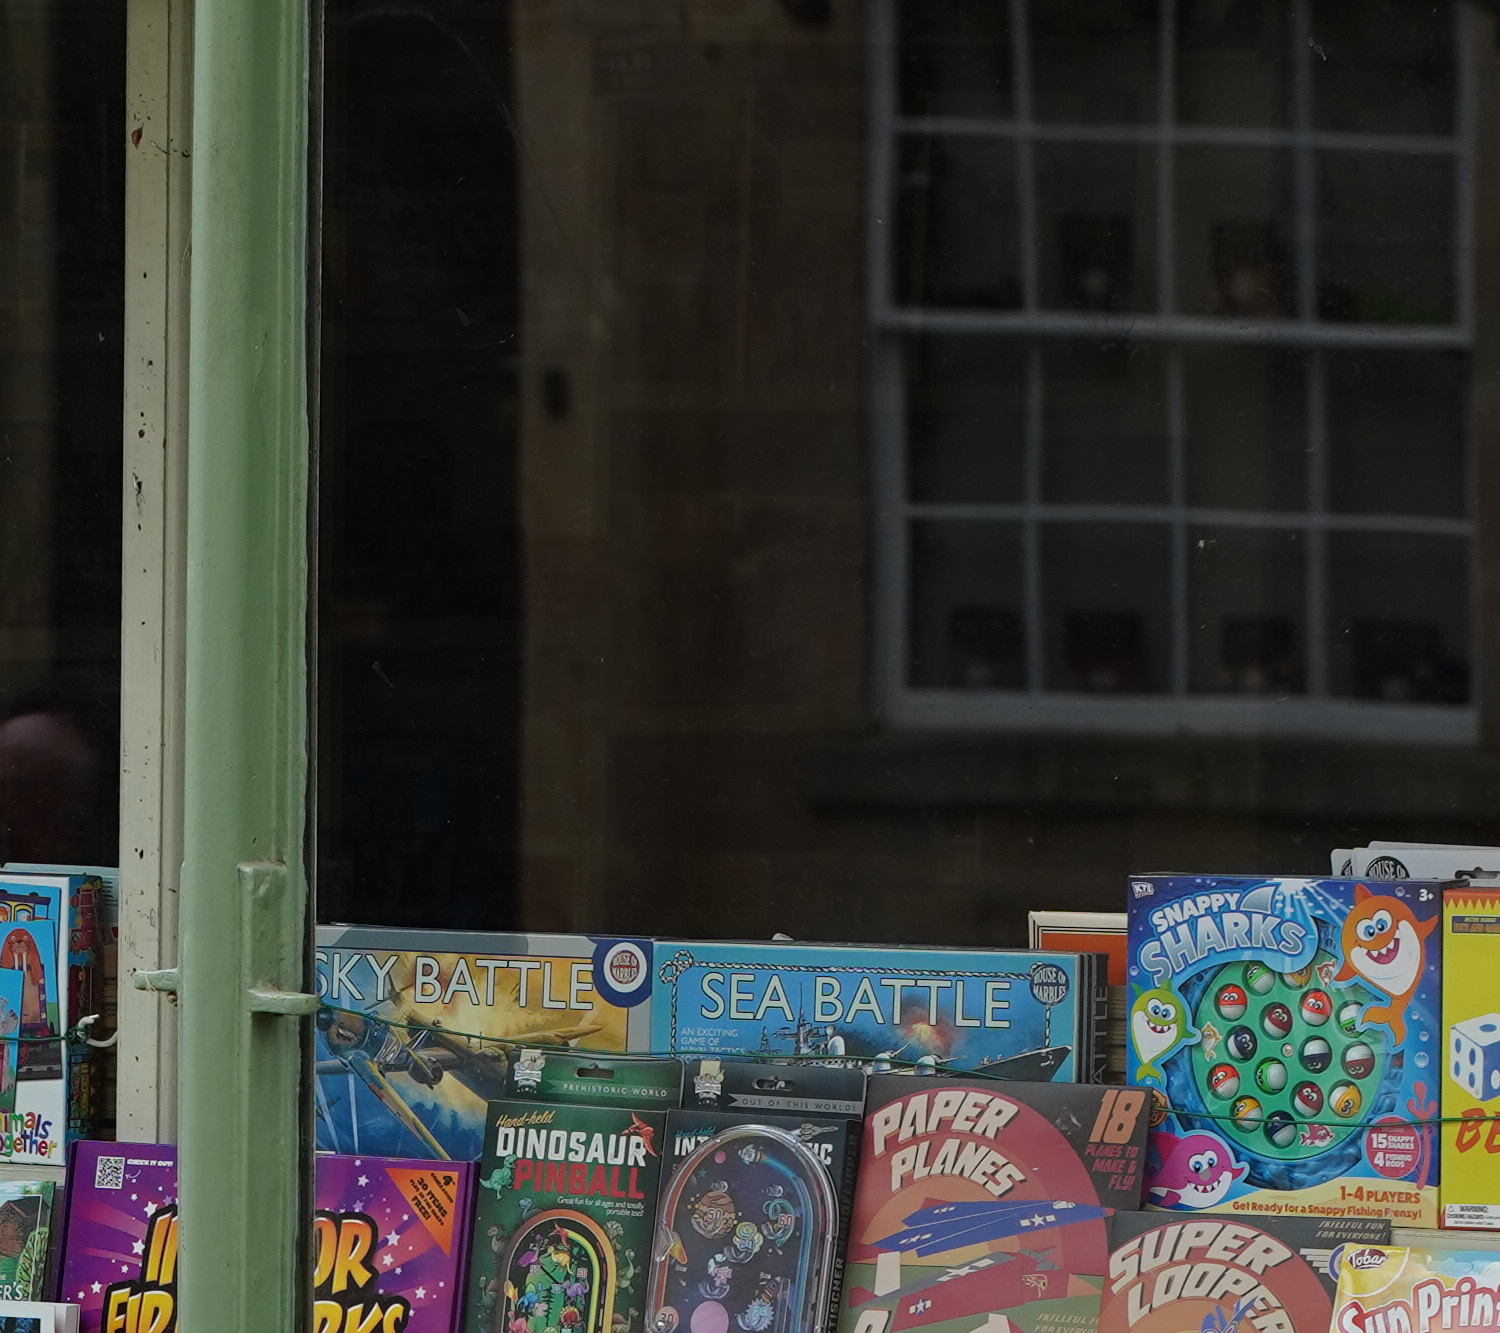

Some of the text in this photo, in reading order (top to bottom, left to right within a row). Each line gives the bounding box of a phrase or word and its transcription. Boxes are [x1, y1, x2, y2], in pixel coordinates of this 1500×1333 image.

[1138, 909, 1306, 981] SHARKS
[495, 1125, 646, 1167] DINOSAUR
[514, 1161, 644, 1200] PINBALL
[1108, 1220, 1255, 1278] SUPER
